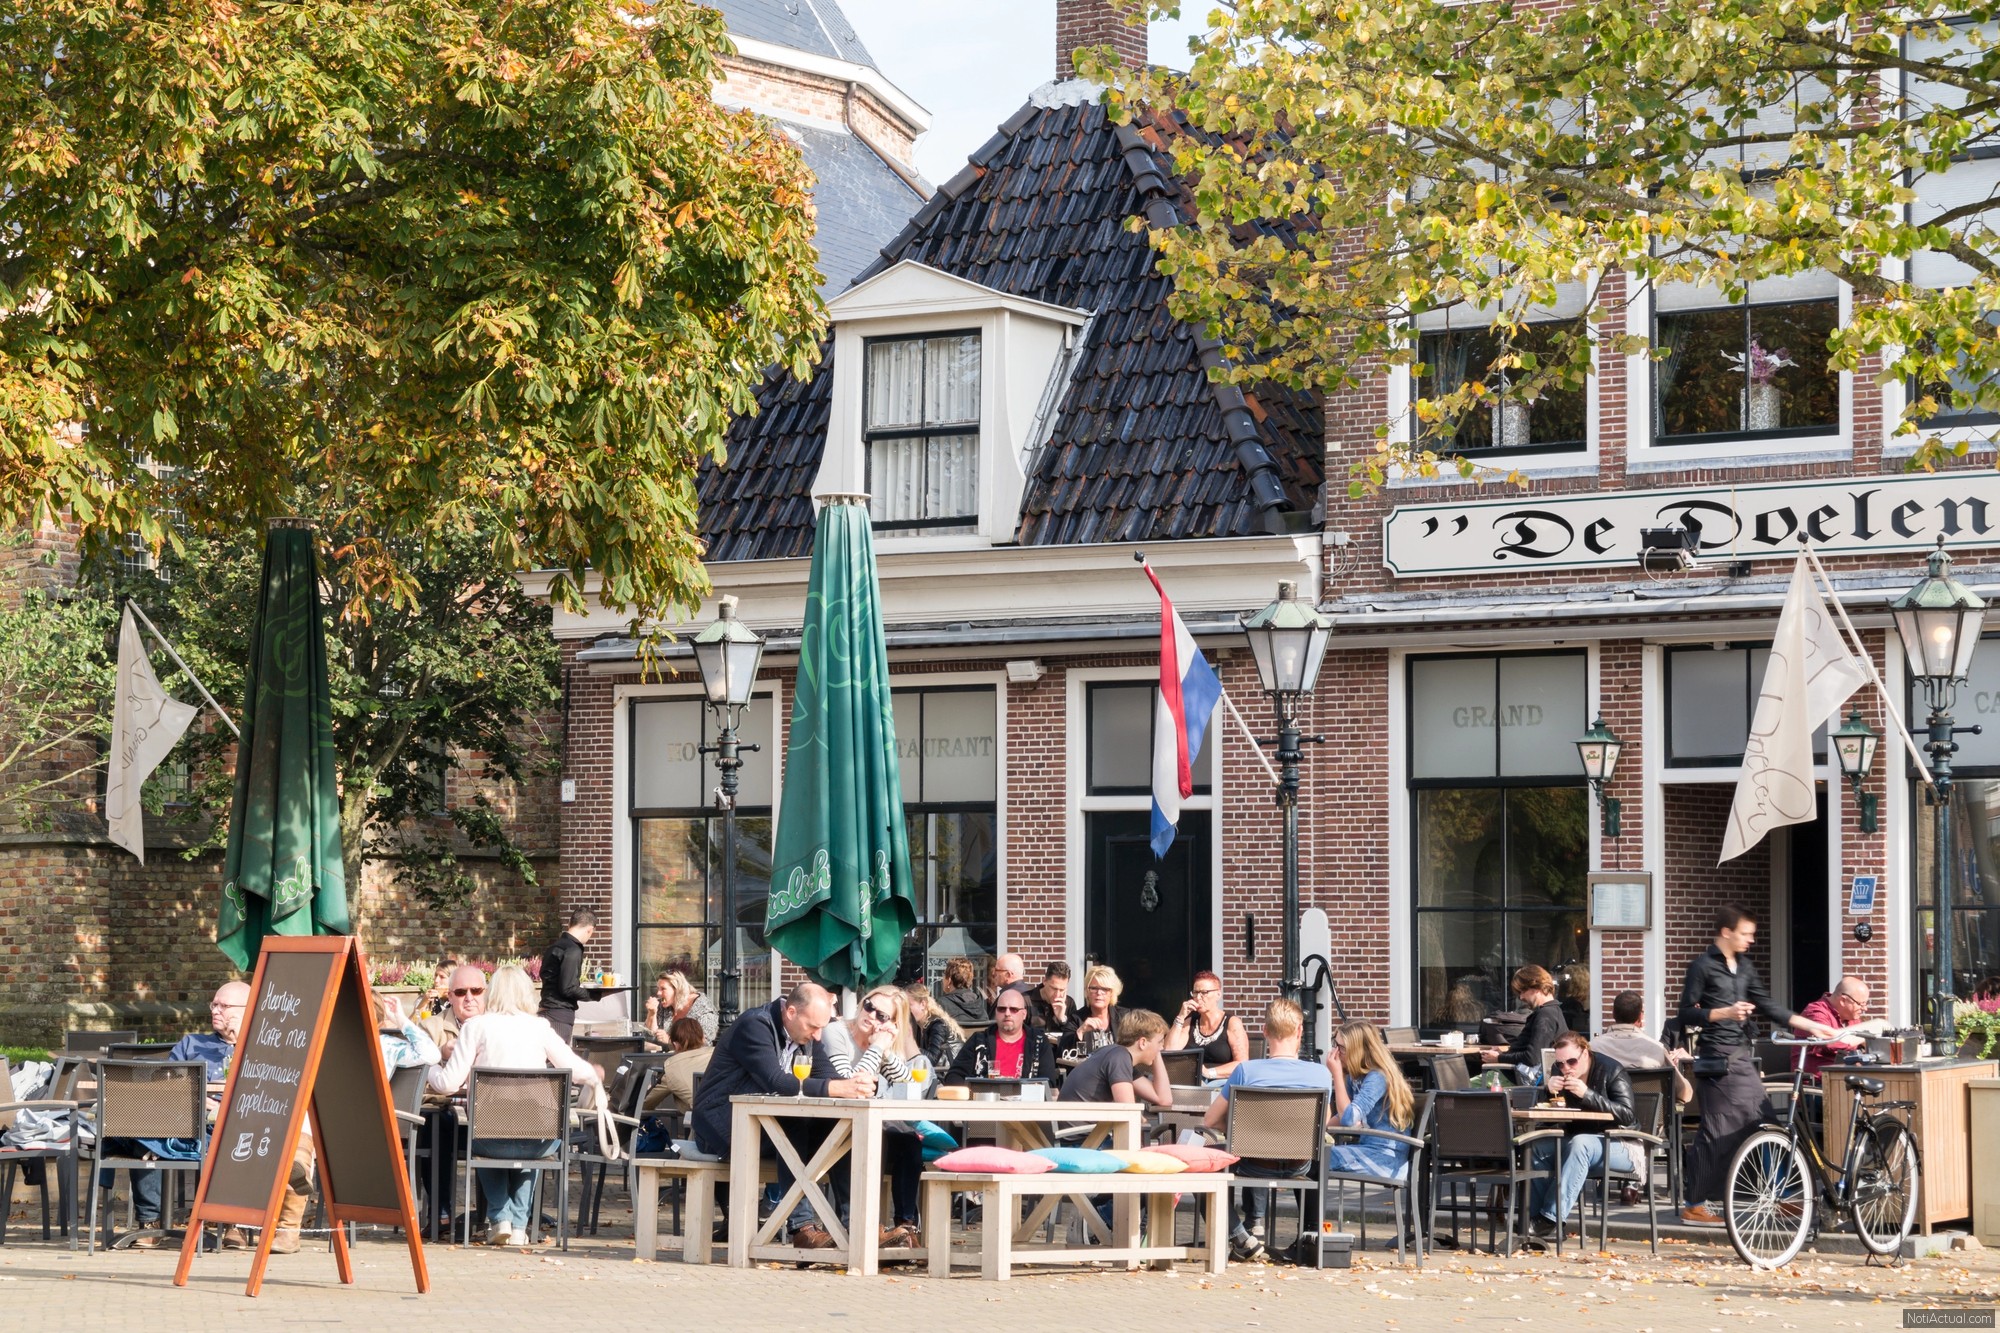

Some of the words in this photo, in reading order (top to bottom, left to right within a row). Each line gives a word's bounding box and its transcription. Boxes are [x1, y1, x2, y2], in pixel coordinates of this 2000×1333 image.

[1655, 488, 1995, 551] Doelen
[1452, 704, 1544, 729] GRAND
[285, 1027, 307, 1049] met
[240, 1053, 301, 1090] huisgemaakte
[236, 1089, 289, 1120] appeltaart
